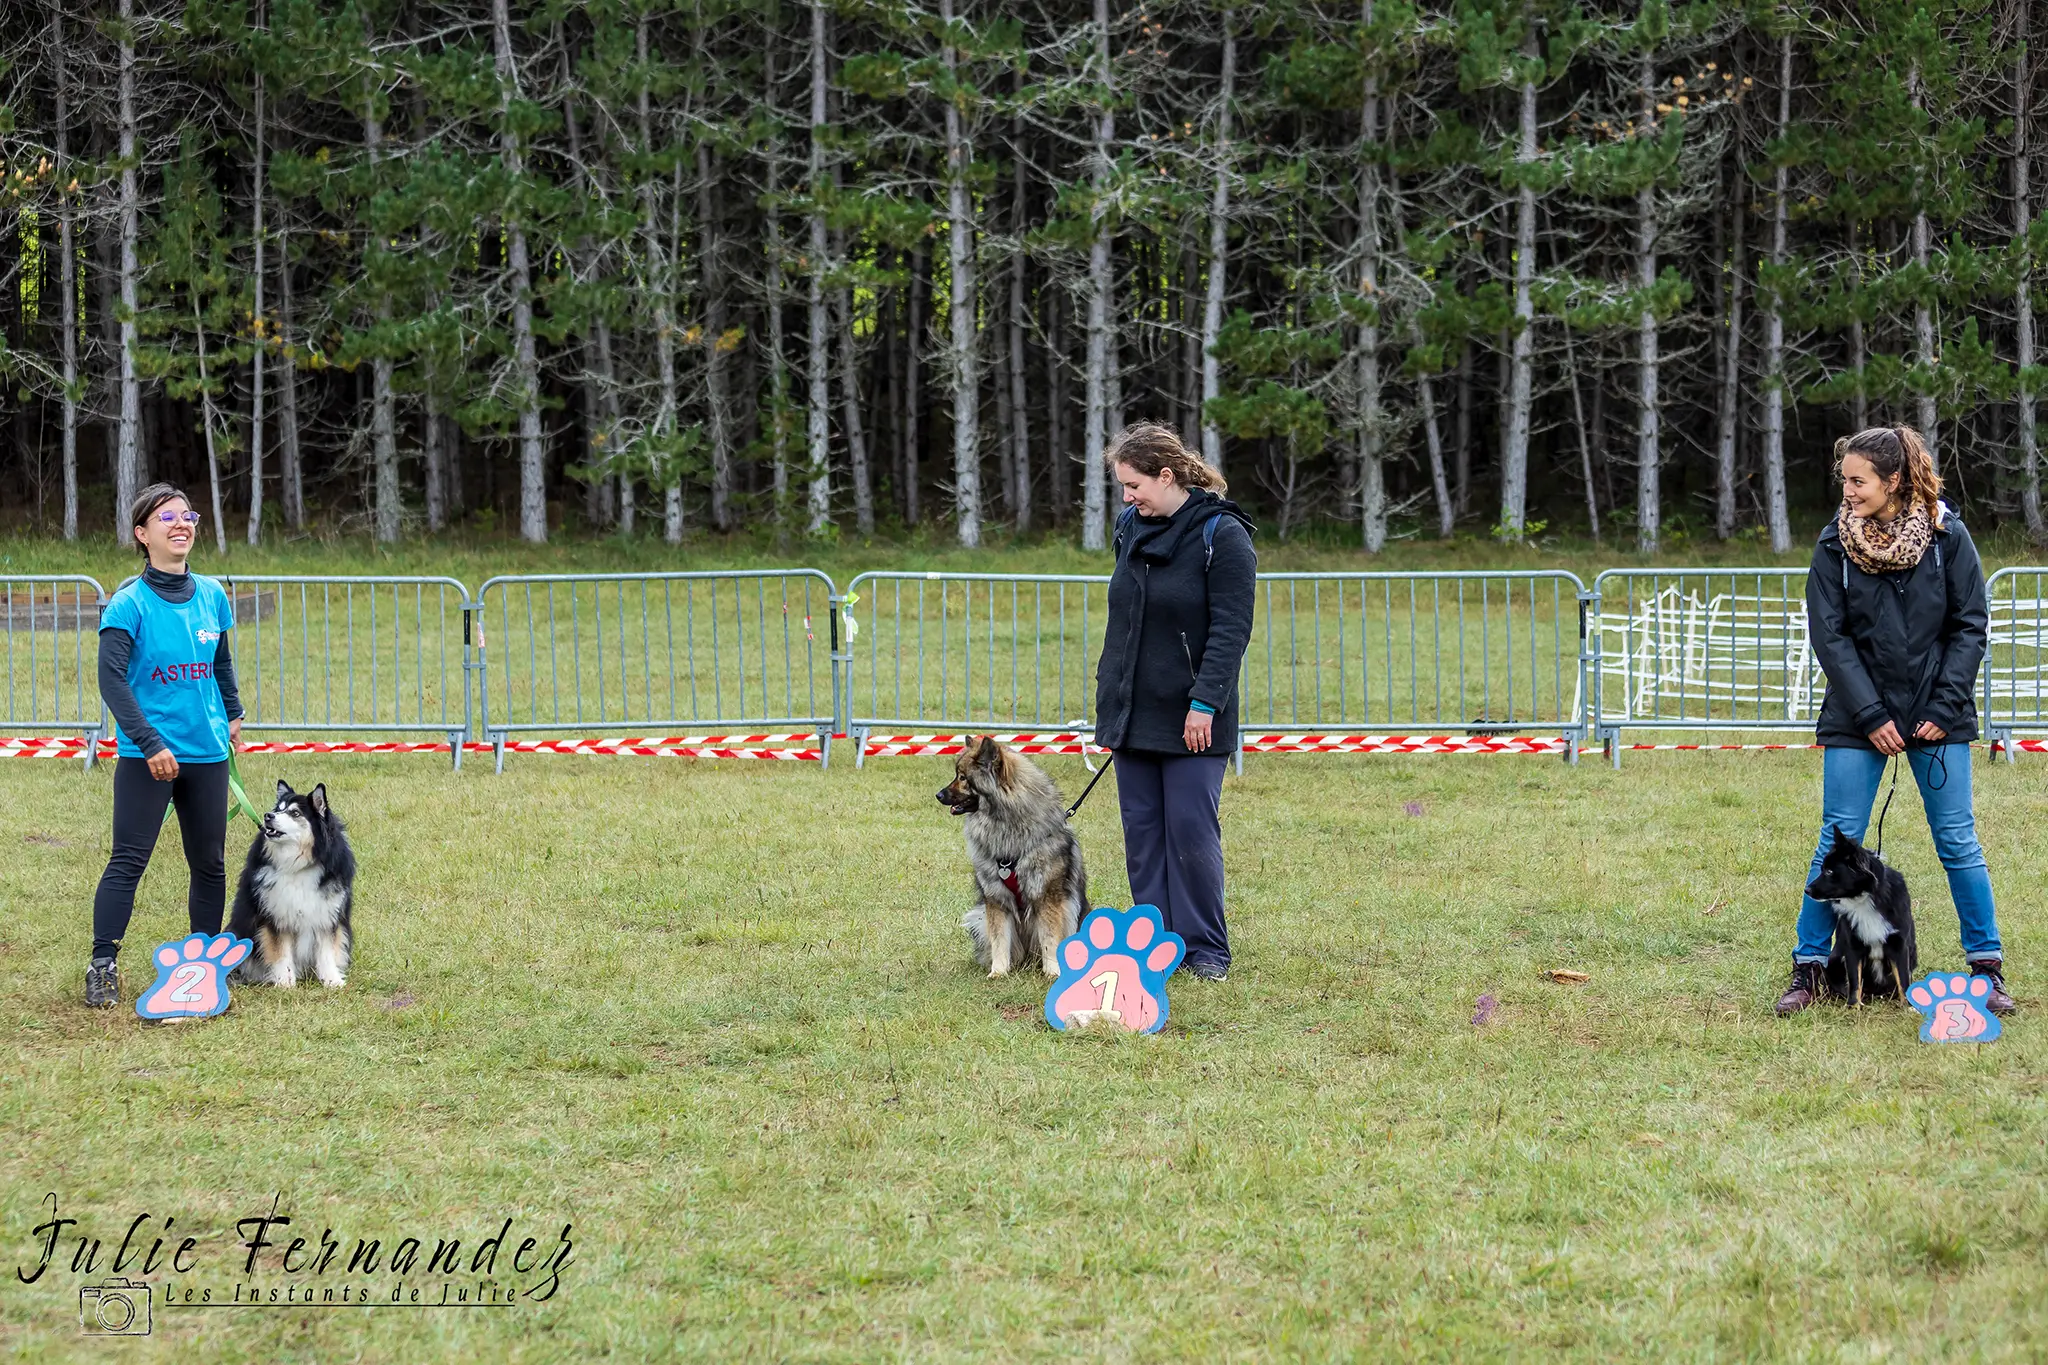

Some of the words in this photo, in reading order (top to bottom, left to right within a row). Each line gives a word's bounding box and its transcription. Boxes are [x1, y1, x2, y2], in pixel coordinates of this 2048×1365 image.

[169, 965, 207, 1003] 2
[1089, 970, 1122, 1020] 1
[1943, 1003, 1971, 1036] 3
